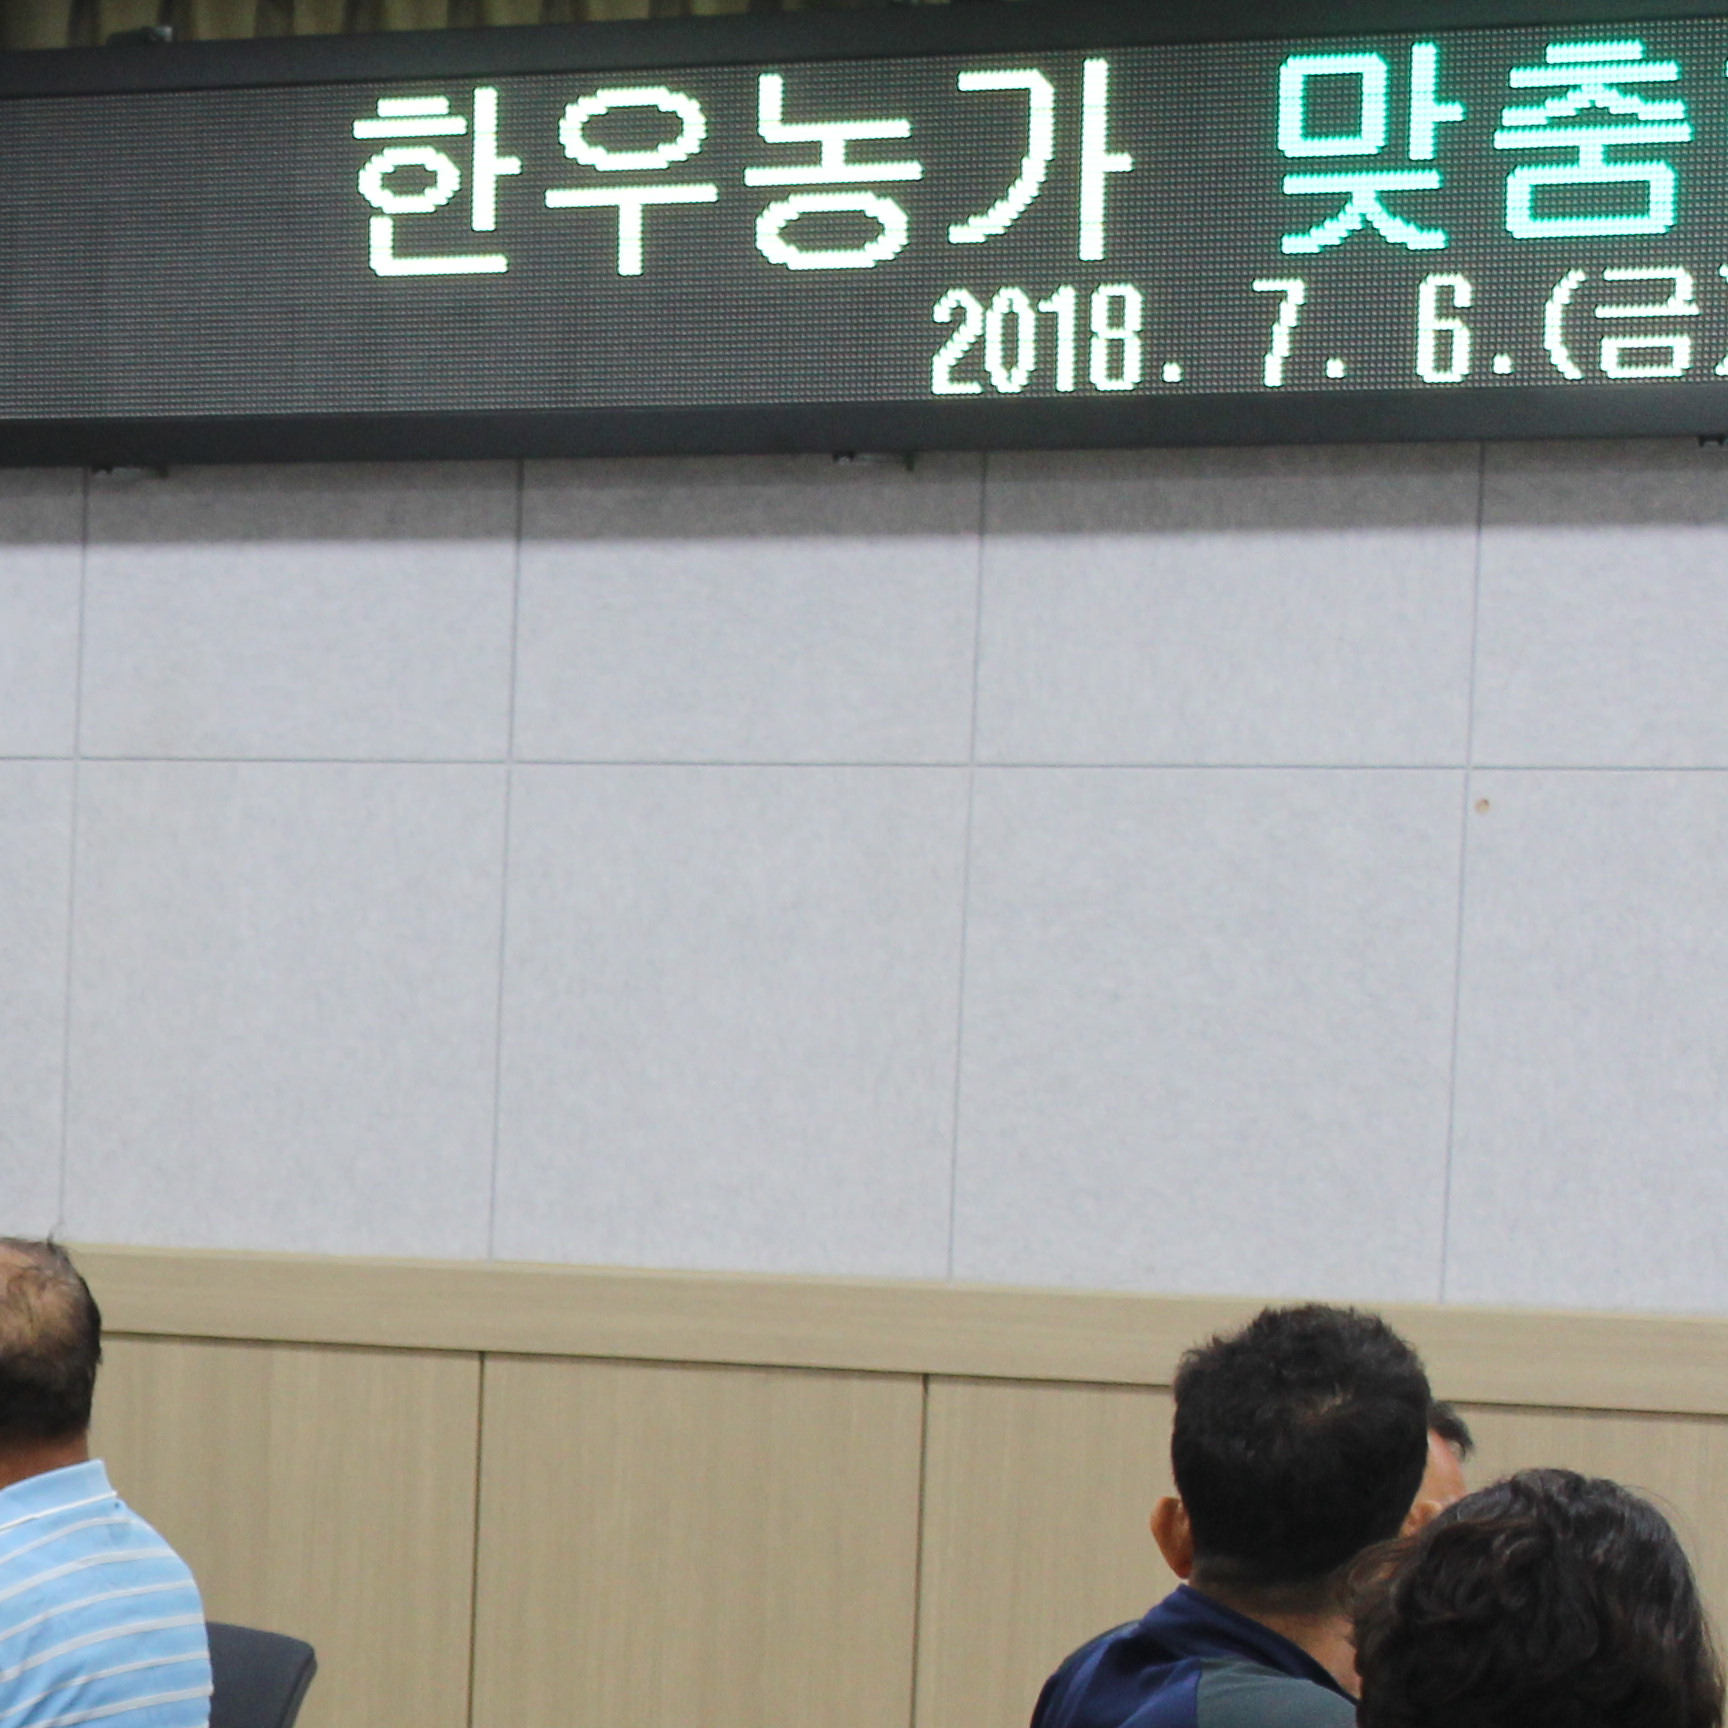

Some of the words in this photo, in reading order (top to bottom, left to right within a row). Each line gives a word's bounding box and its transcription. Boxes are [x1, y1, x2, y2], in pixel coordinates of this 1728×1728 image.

[351, 57, 1135, 276] 한우농가
[931, 283, 1183, 396] 2018.
[1251, 276, 1346, 388] 7.
[1415, 264, 1728, 384] 6.(금
